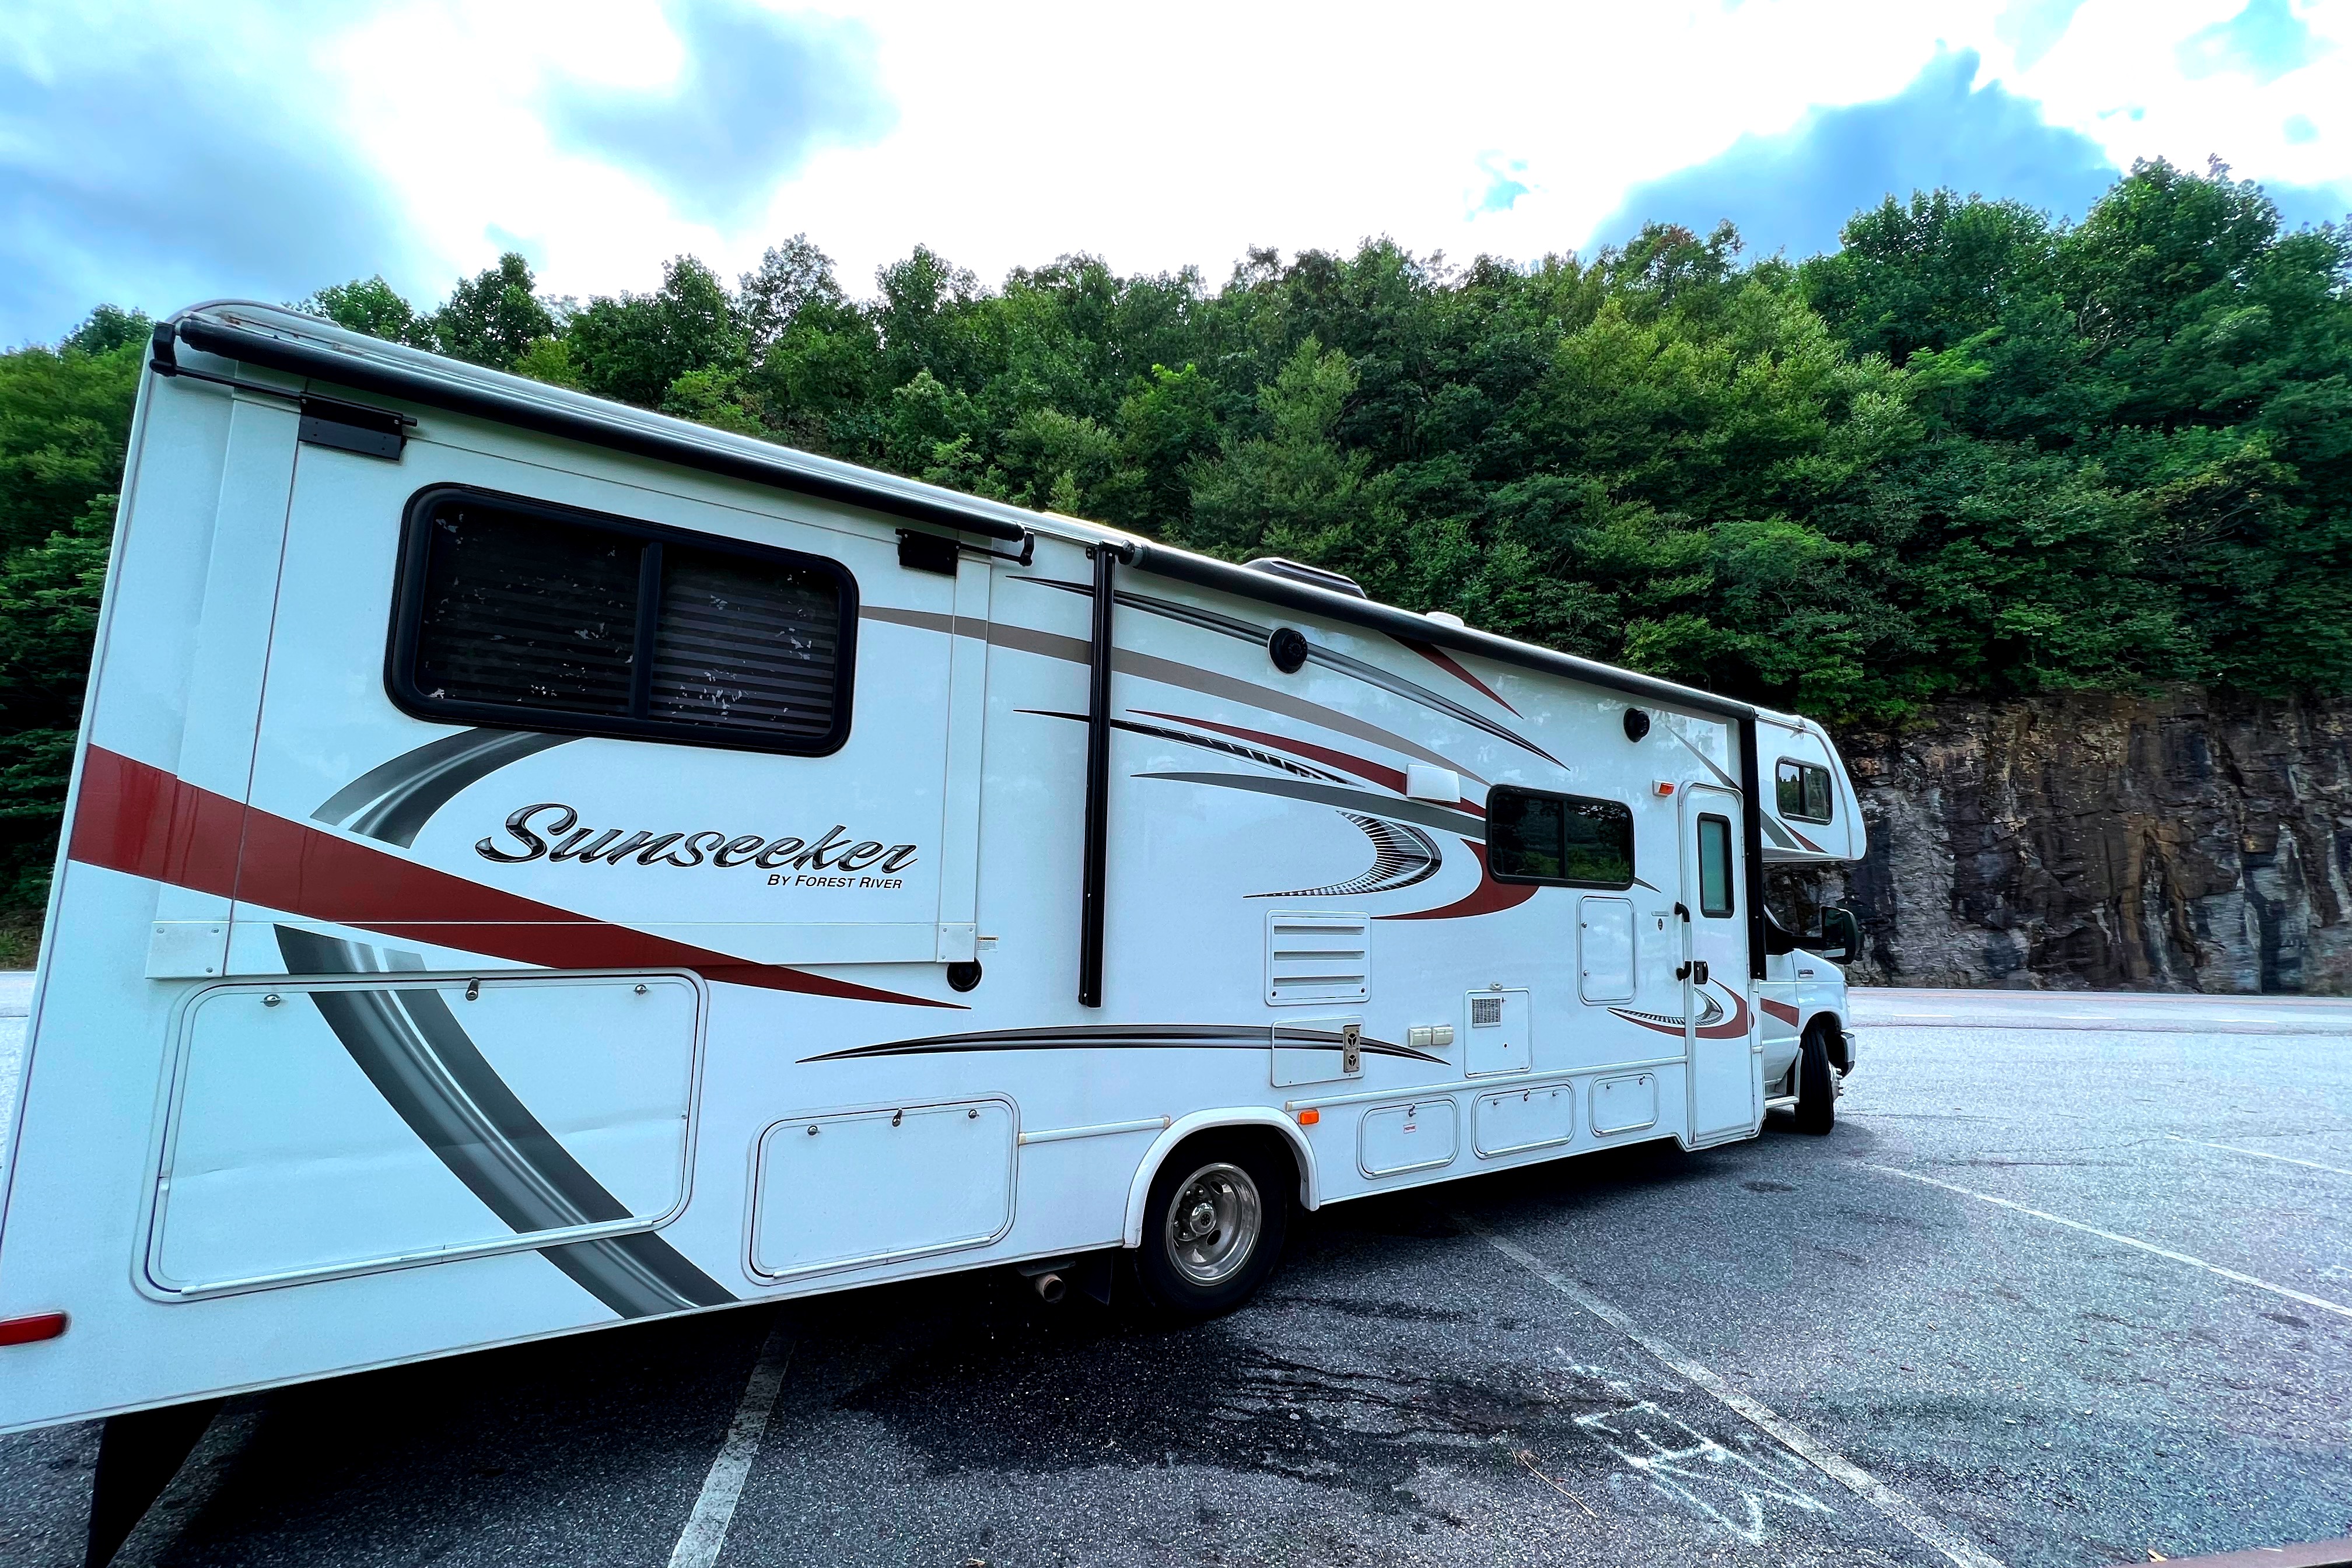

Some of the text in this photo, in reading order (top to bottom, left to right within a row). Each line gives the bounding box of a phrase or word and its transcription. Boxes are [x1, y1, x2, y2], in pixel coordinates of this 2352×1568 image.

[475, 803, 918, 874] Sunseeker
[767, 874, 902, 889] BY FOREST RIVER
